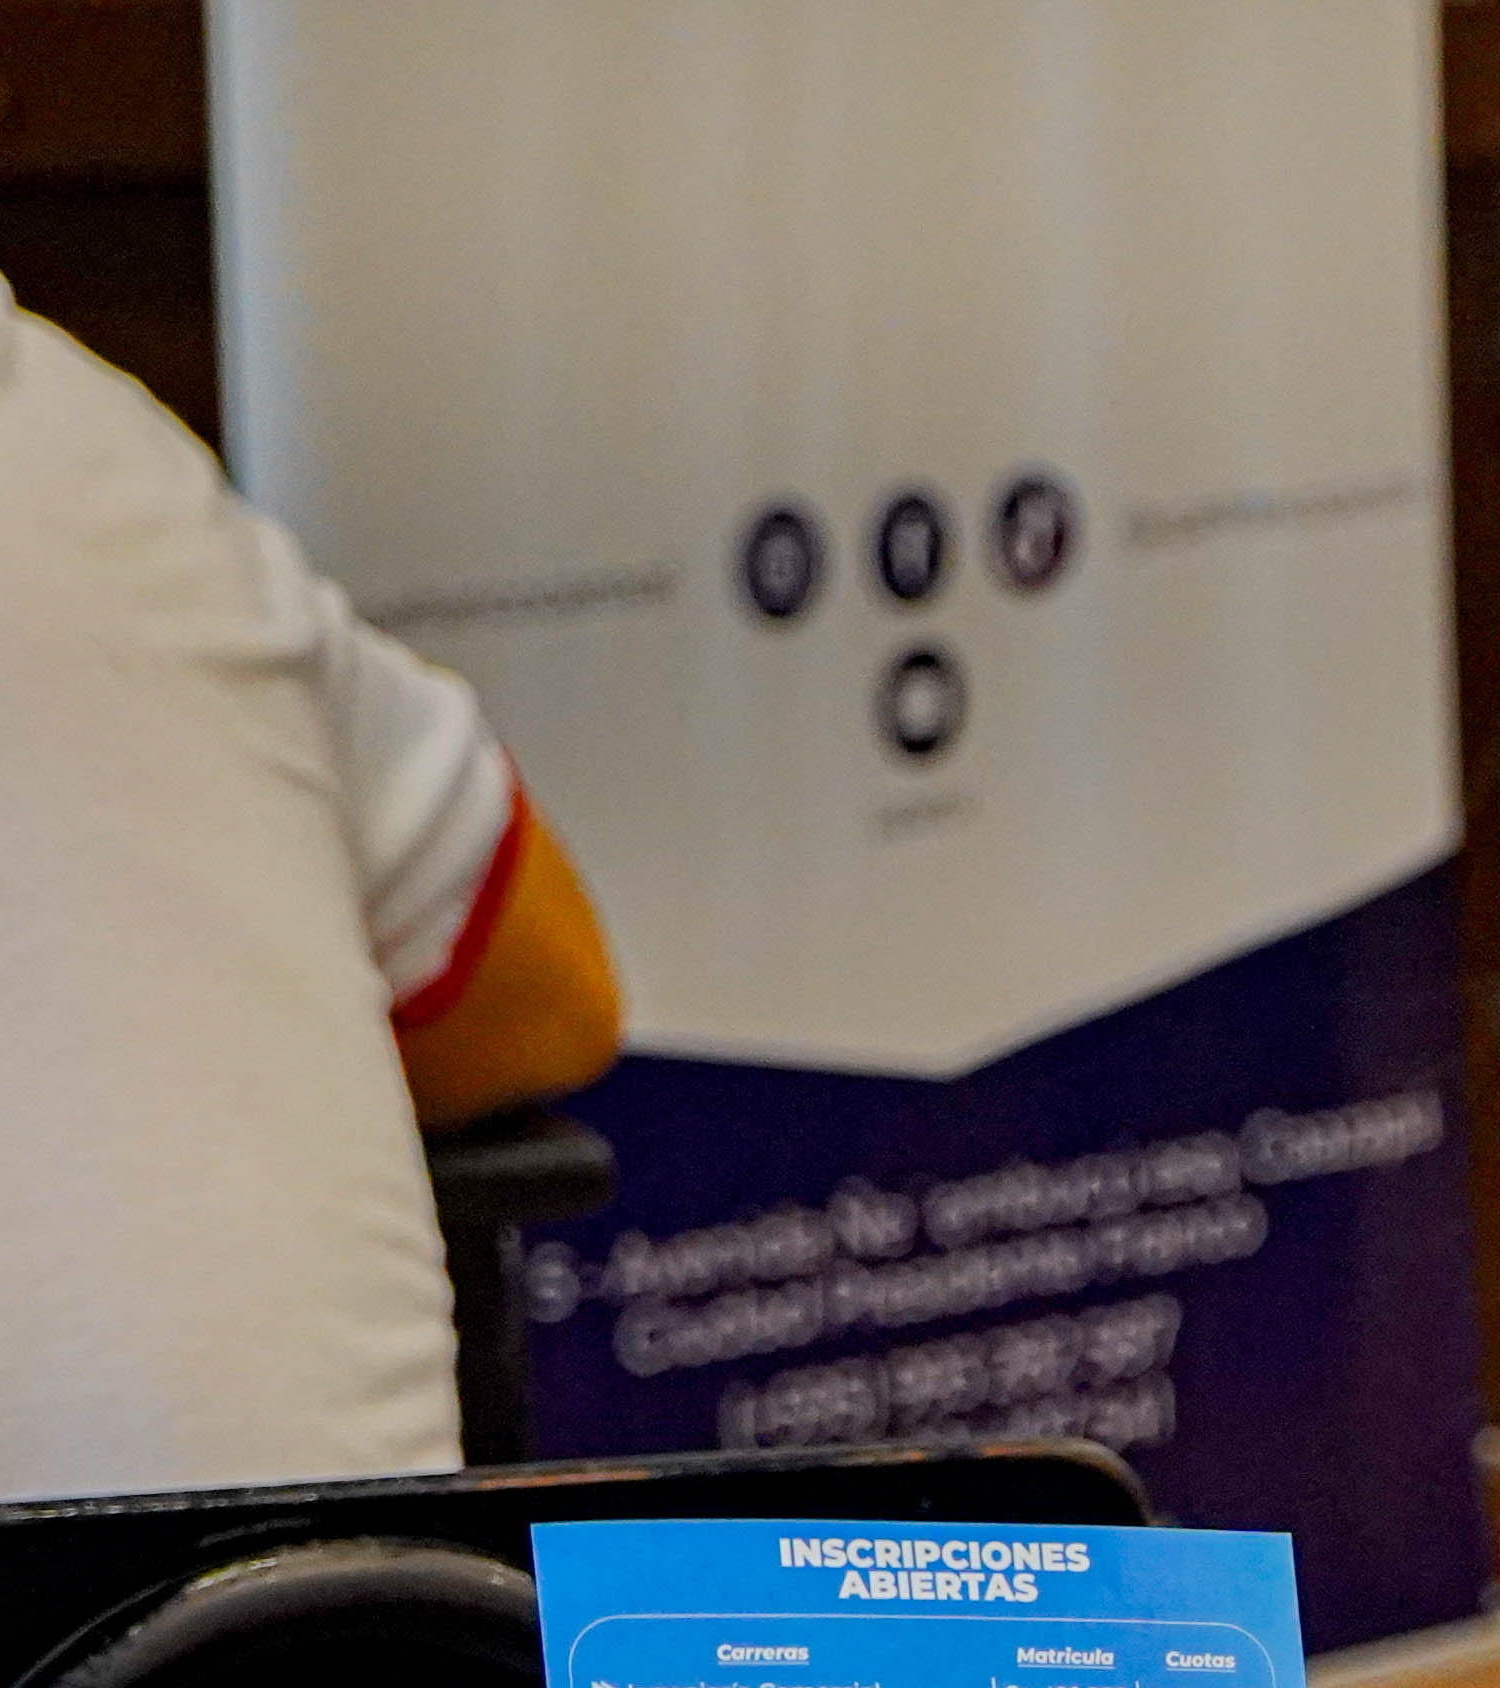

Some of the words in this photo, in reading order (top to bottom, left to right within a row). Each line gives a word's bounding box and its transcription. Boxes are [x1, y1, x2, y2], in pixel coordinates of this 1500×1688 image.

[779, 1538, 1090, 1572] INSCRIPCIONES
[838, 1570, 1039, 1602] ABIERTAS
[716, 1644, 809, 1662] Carreras
[1165, 1650, 1236, 1668] Cuotas
